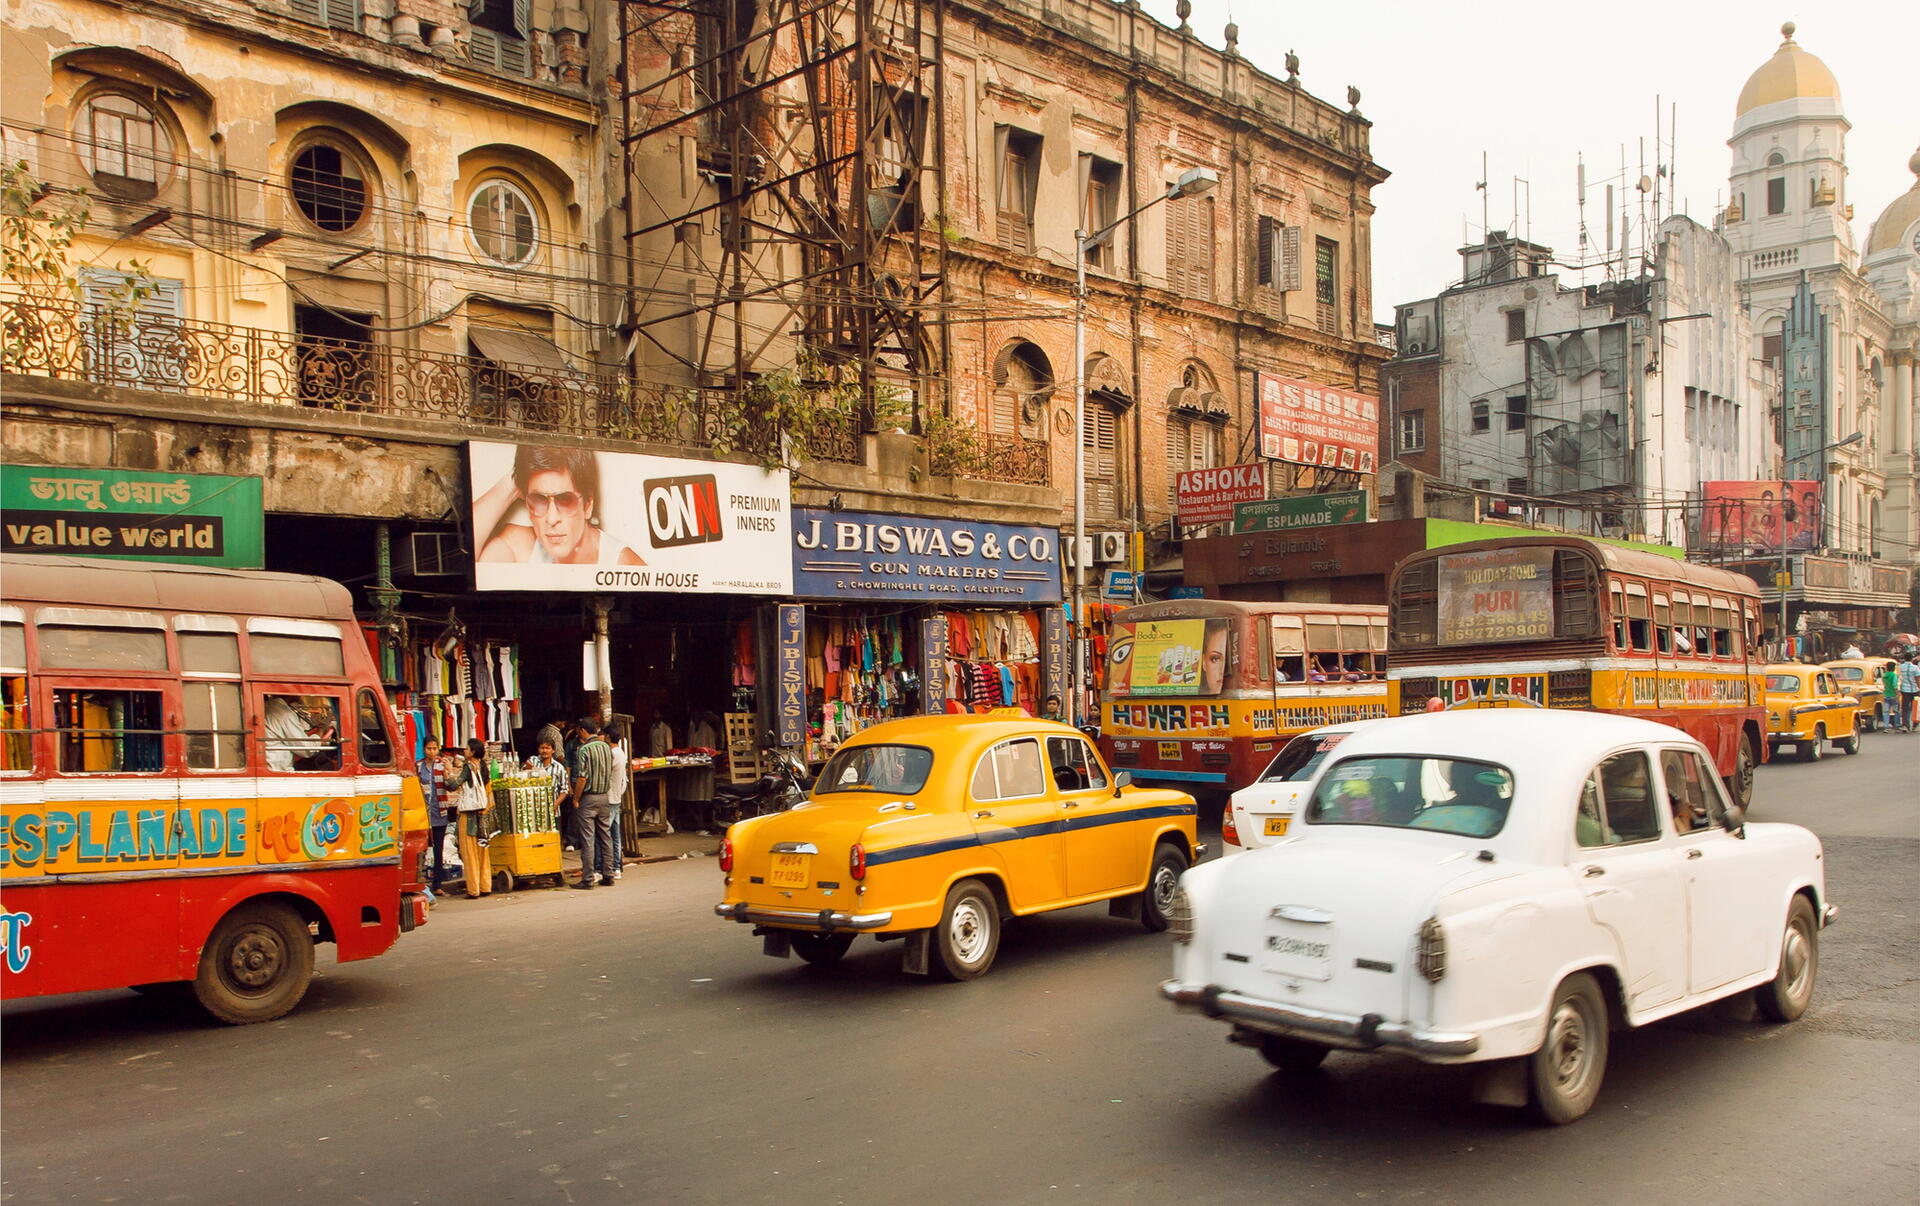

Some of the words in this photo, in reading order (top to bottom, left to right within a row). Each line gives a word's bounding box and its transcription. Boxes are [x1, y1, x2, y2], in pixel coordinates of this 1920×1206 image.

[1263, 380, 1377, 422] ASHOKA
[1274, 405, 1320, 422] RESTAURANT
[1264, 415, 1291, 431] MULTI
[1292, 421, 1327, 437] CUISINE
[1328, 427, 1375, 446] RESTAURANT
[1178, 465, 1262, 494] ASHOKA
[29, 477, 108, 510] ভ্যালু
[730, 494, 781, 513] PREMIUM
[1178, 494, 1215, 505] Restaurant
[1215, 491, 1221, 501] &
[1222, 491, 1234, 501] Bar
[648, 481, 719, 543] ONN
[1266, 511, 1332, 528] ESPLANADE
[6, 519, 112, 547] value
[121, 523, 214, 549] world
[736, 515, 776, 533] INNERS
[797, 519, 829, 550] J.
[834, 522, 975, 558] BISWAS
[981, 532, 1001, 560] &
[1007, 534, 1054, 561] CO.
[1264, 536, 1328, 558] Esplanade
[595, 570, 651, 588] COTTON
[655, 572, 700, 588] HOUSE
[870, 561, 910, 575] GUN
[916, 563, 999, 579] MAKERS
[1463, 567, 1507, 585] HOLIDAY
[1509, 563, 1537, 582] HOME
[766, 582, 782, 590] BROS
[850, 580, 924, 592] CHOWRINGHEE
[1473, 590, 1520, 615] PURI
[783, 629, 801, 645] J
[1049, 628, 1061, 641] J
[928, 641, 942, 655] J
[782, 647, 802, 717] BISWAS
[928, 657, 943, 714] BISWA
[1438, 675, 1545, 708] HOWRAH
[787, 718, 797, 730] &
[1111, 704, 1231, 733] HOWRAH
[1252, 706, 1325, 731] BHATTANAGAR
[1359, 703, 1386, 719] SALKIA
[782, 731, 804, 743] CO.
[360, 797, 392, 827] BS
